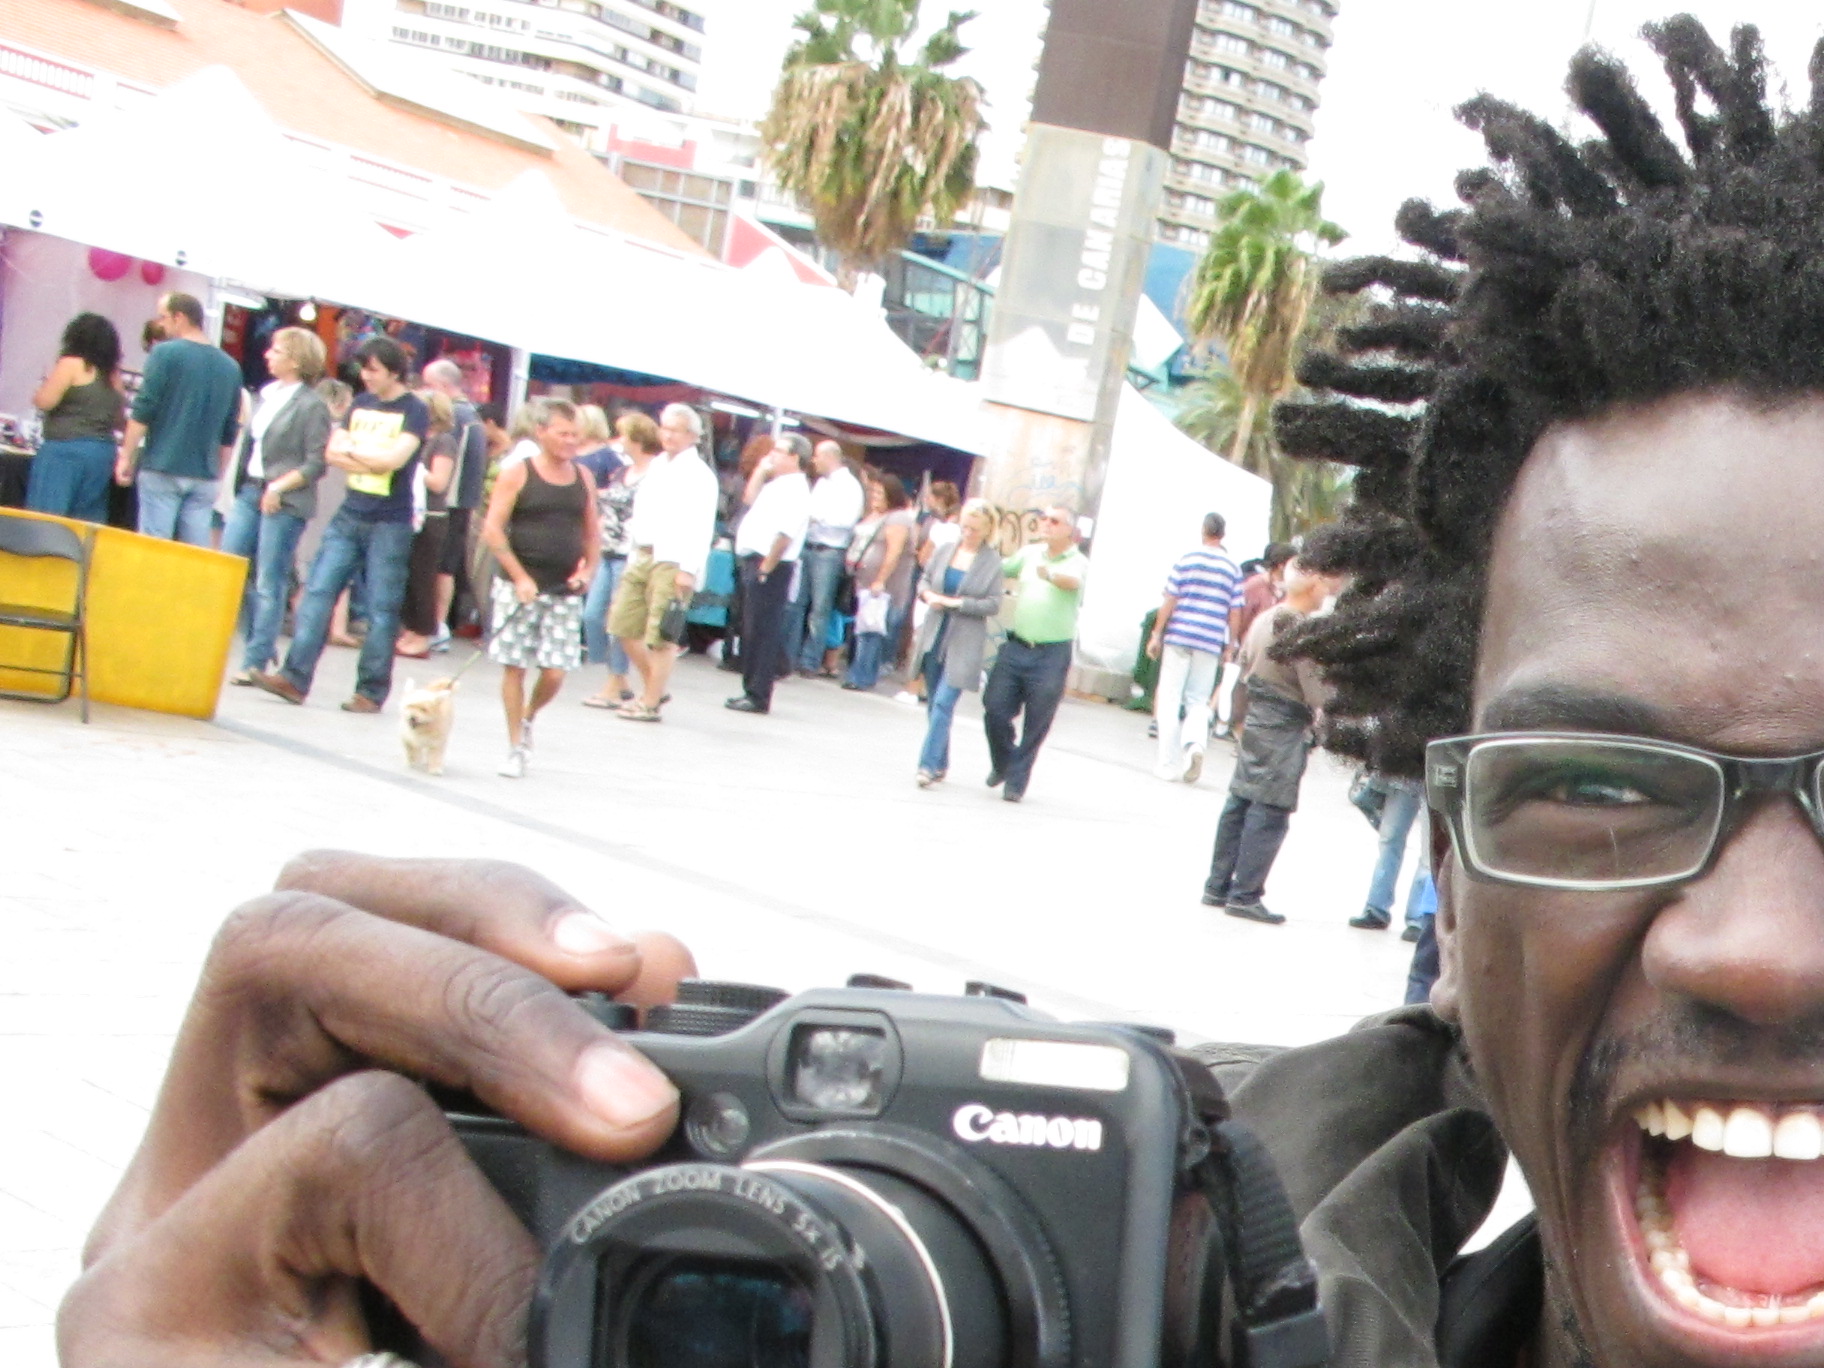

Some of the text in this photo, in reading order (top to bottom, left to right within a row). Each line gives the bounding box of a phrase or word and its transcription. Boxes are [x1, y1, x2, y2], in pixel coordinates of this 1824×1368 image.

[1067, 137, 1131, 345] DE CANARIAS
[953, 1104, 1103, 1151] Canon
[571, 1182, 642, 1245] CANON
[653, 1170, 722, 1195] ZOOM
[733, 1176, 785, 1215] LENS
